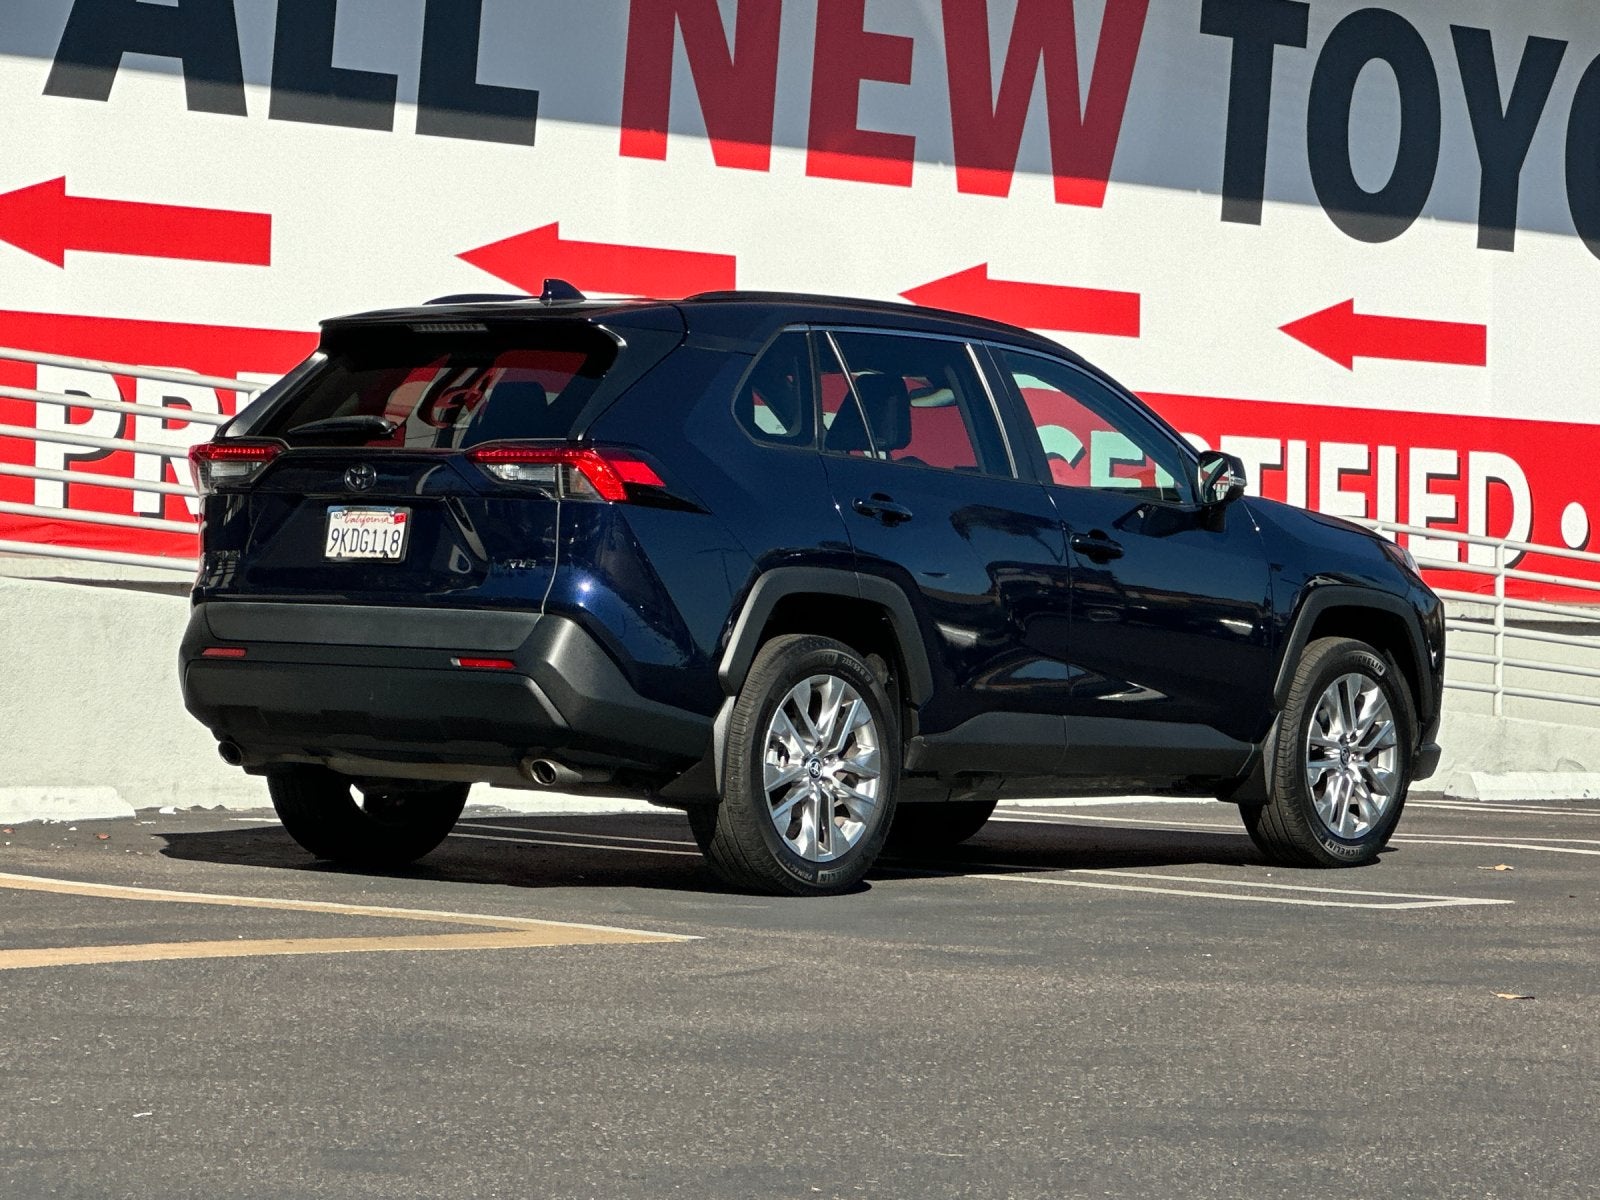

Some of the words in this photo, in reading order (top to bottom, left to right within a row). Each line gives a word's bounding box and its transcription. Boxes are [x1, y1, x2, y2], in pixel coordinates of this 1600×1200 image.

[618, 0, 1150, 209] NEW
[1200, 0, 1600, 263] TOY
[33, 363, 289, 517] PR
[328, 527, 401, 555] 9KDG118
[344, 511, 395, 528] California
